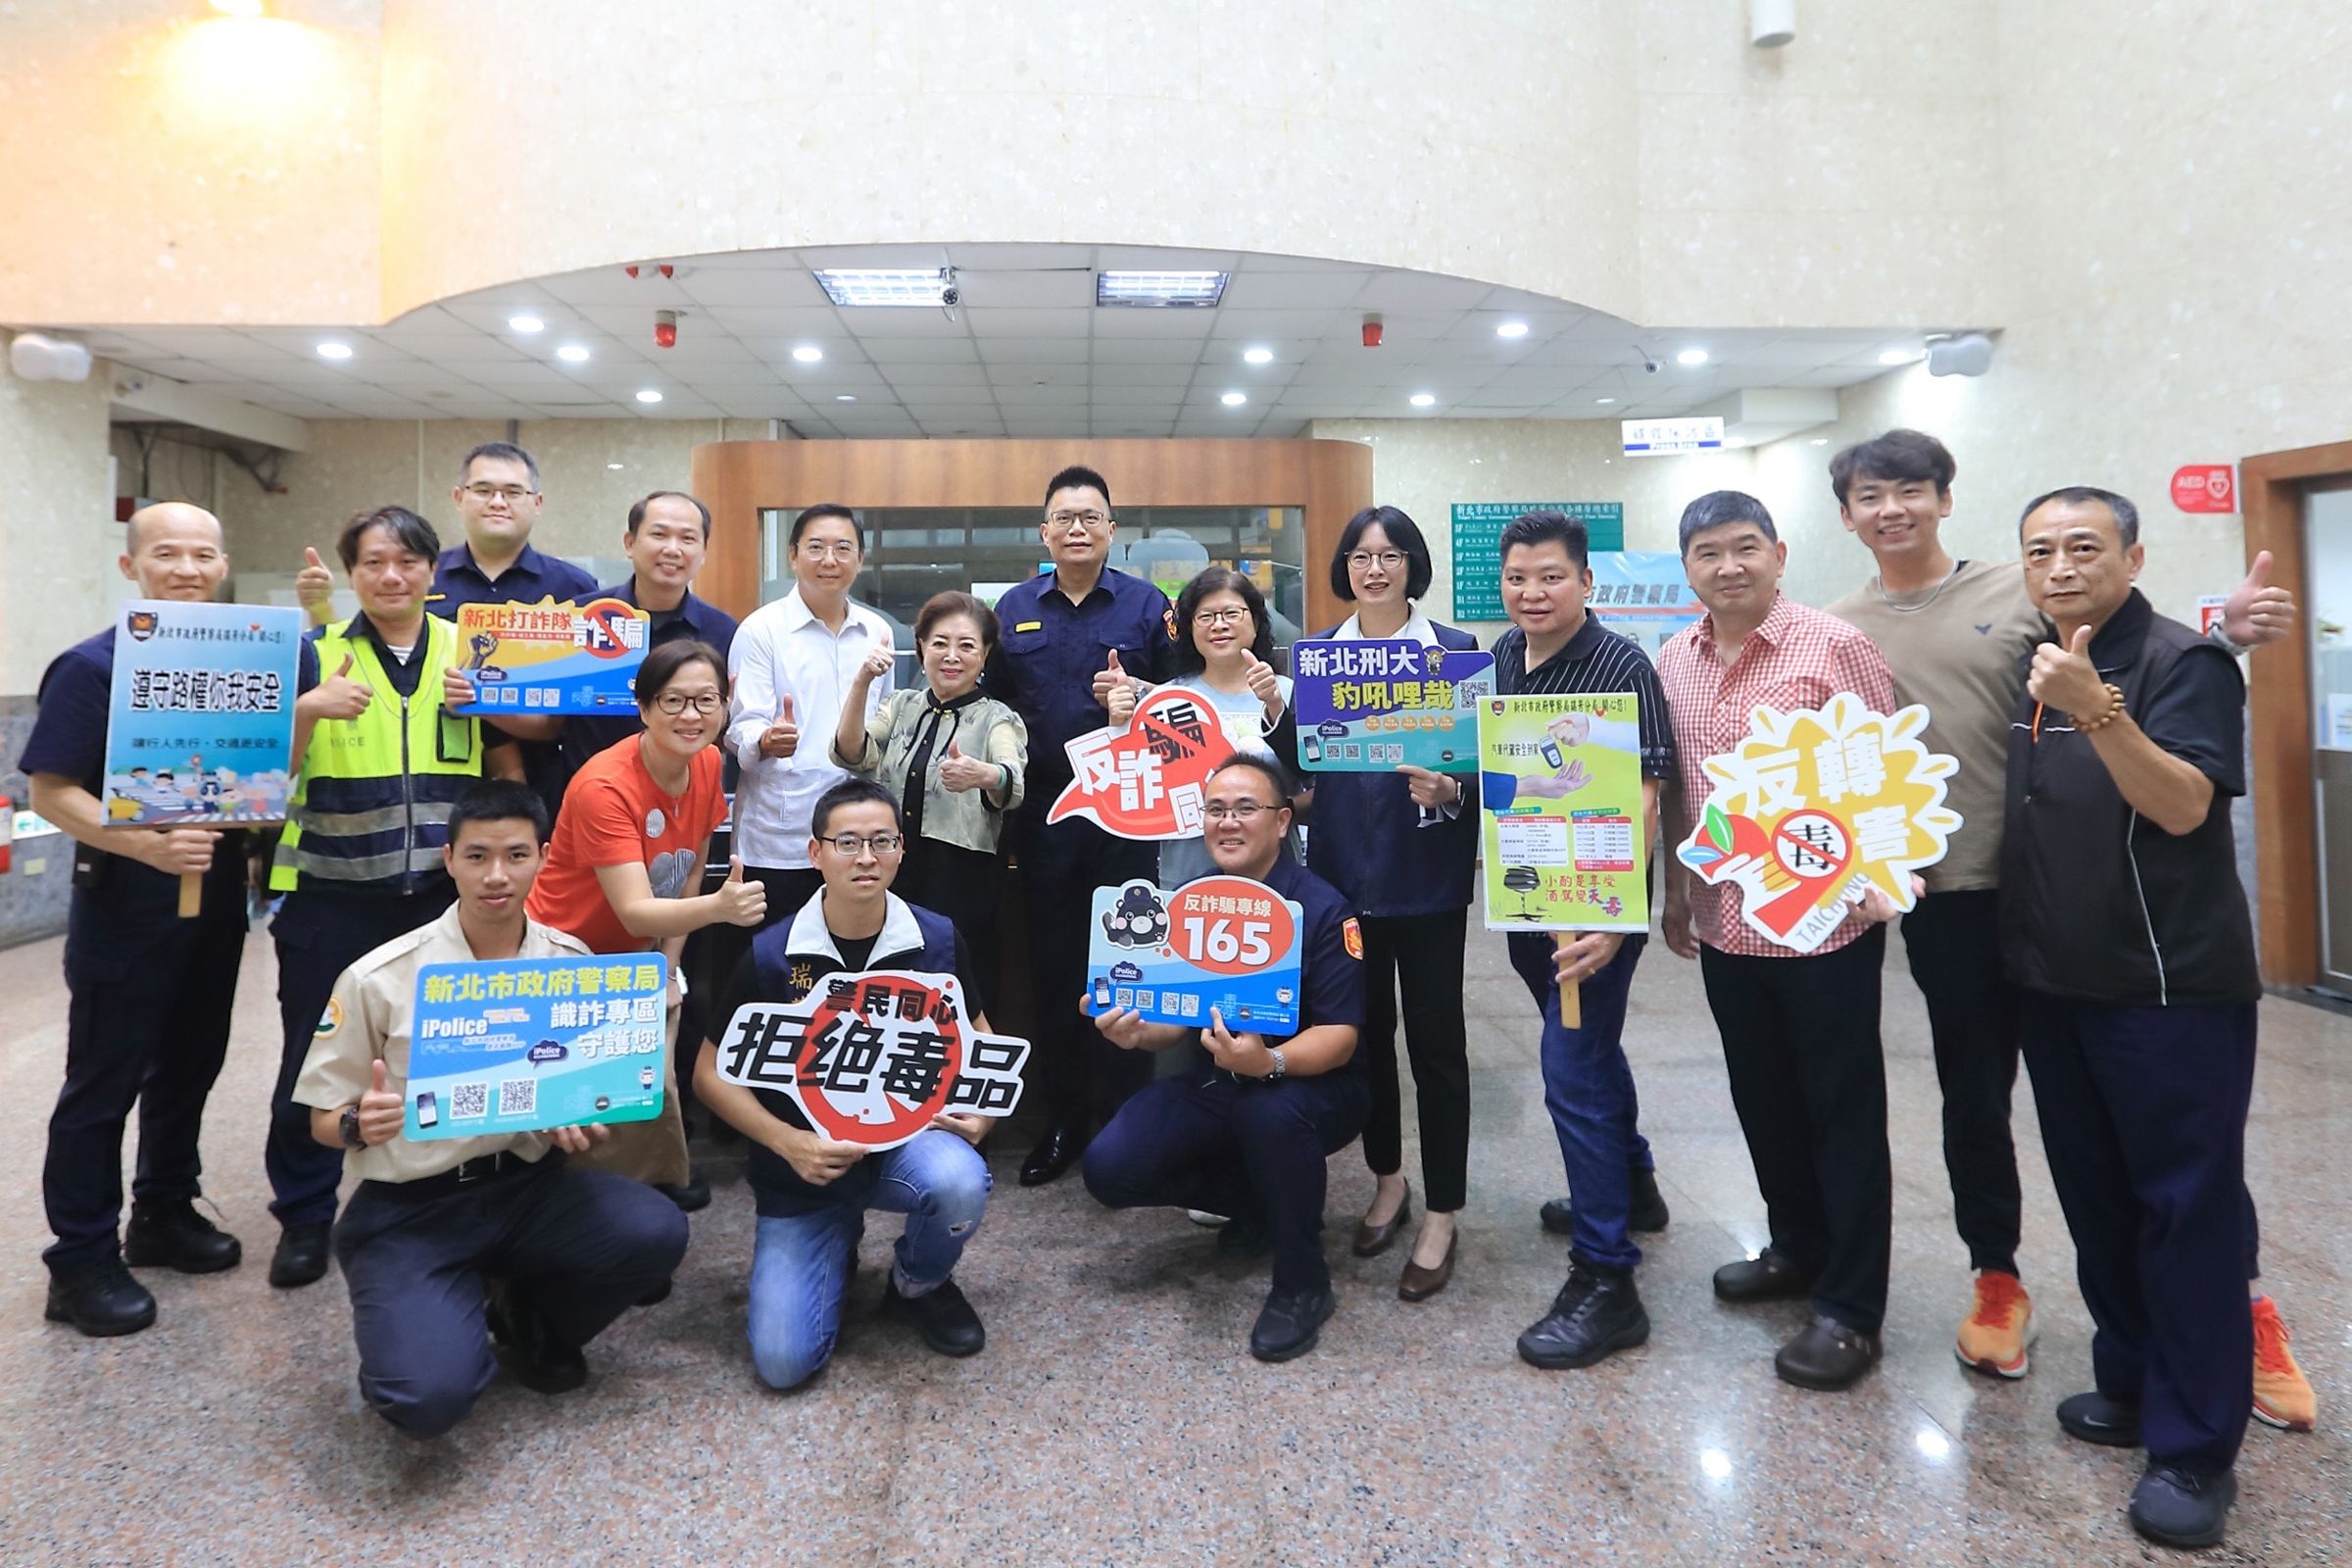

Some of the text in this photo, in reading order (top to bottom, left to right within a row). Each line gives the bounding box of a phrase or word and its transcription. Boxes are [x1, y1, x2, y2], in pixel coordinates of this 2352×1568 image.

[464, 609, 572, 630] 新北打詐隊
[573, 616, 643, 650] 詐騙
[1299, 646, 1419, 677] 新北刑大
[131, 668, 280, 710] 遵守路權你我安全
[1332, 680, 1454, 710] 豹吼哩哉
[1545, 874, 1615, 888] 小酌是享受
[1184, 893, 1272, 918] 反詐騙專線
[1184, 917, 1271, 966] 165
[423, 964, 661, 1004] 新北市政府警察局
[550, 998, 659, 1029] 識詐專區
[826, 978, 957, 1026] 警民同心
[421, 1017, 488, 1039] iPolice
[577, 1030, 659, 1058] 守護您
